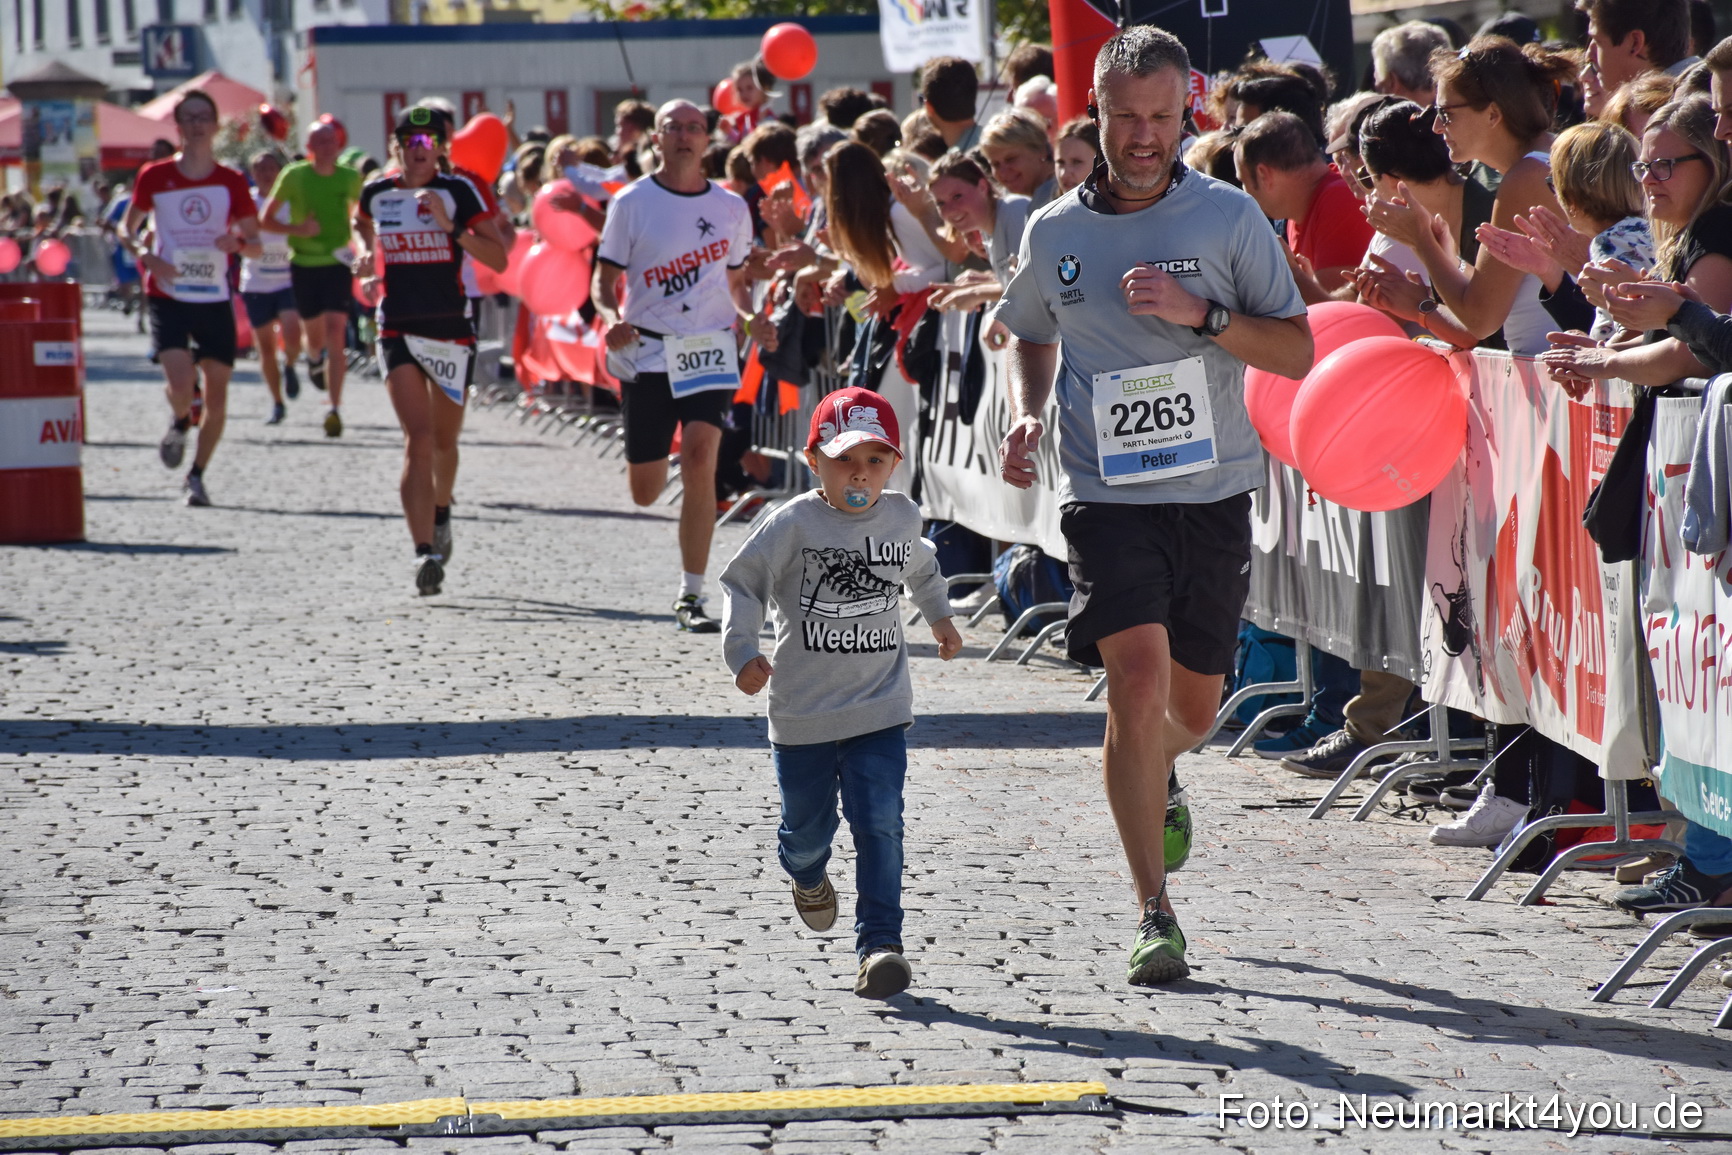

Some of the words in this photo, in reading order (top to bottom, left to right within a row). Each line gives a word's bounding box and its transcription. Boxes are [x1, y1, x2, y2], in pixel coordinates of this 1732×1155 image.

[643, 239, 729, 288] FINISHER
[1145, 258, 1201, 273] OCK
[663, 265, 699, 297] 2017
[1180, 271, 1203, 279] concepts
[1060, 289, 1084, 300] PARTL
[1062, 297, 1086, 306] Neumarkt
[676, 348, 726, 372] 3072
[1122, 373, 1175, 392] BOCK
[1110, 393, 1195, 437] 2263
[1122, 439, 1147, 449] PARTL
[1148, 434, 1183, 445] Neumarkt
[1141, 452, 1178, 468] Peter
[865, 536, 913, 572] Long
[802, 620, 897, 654] Weekend
